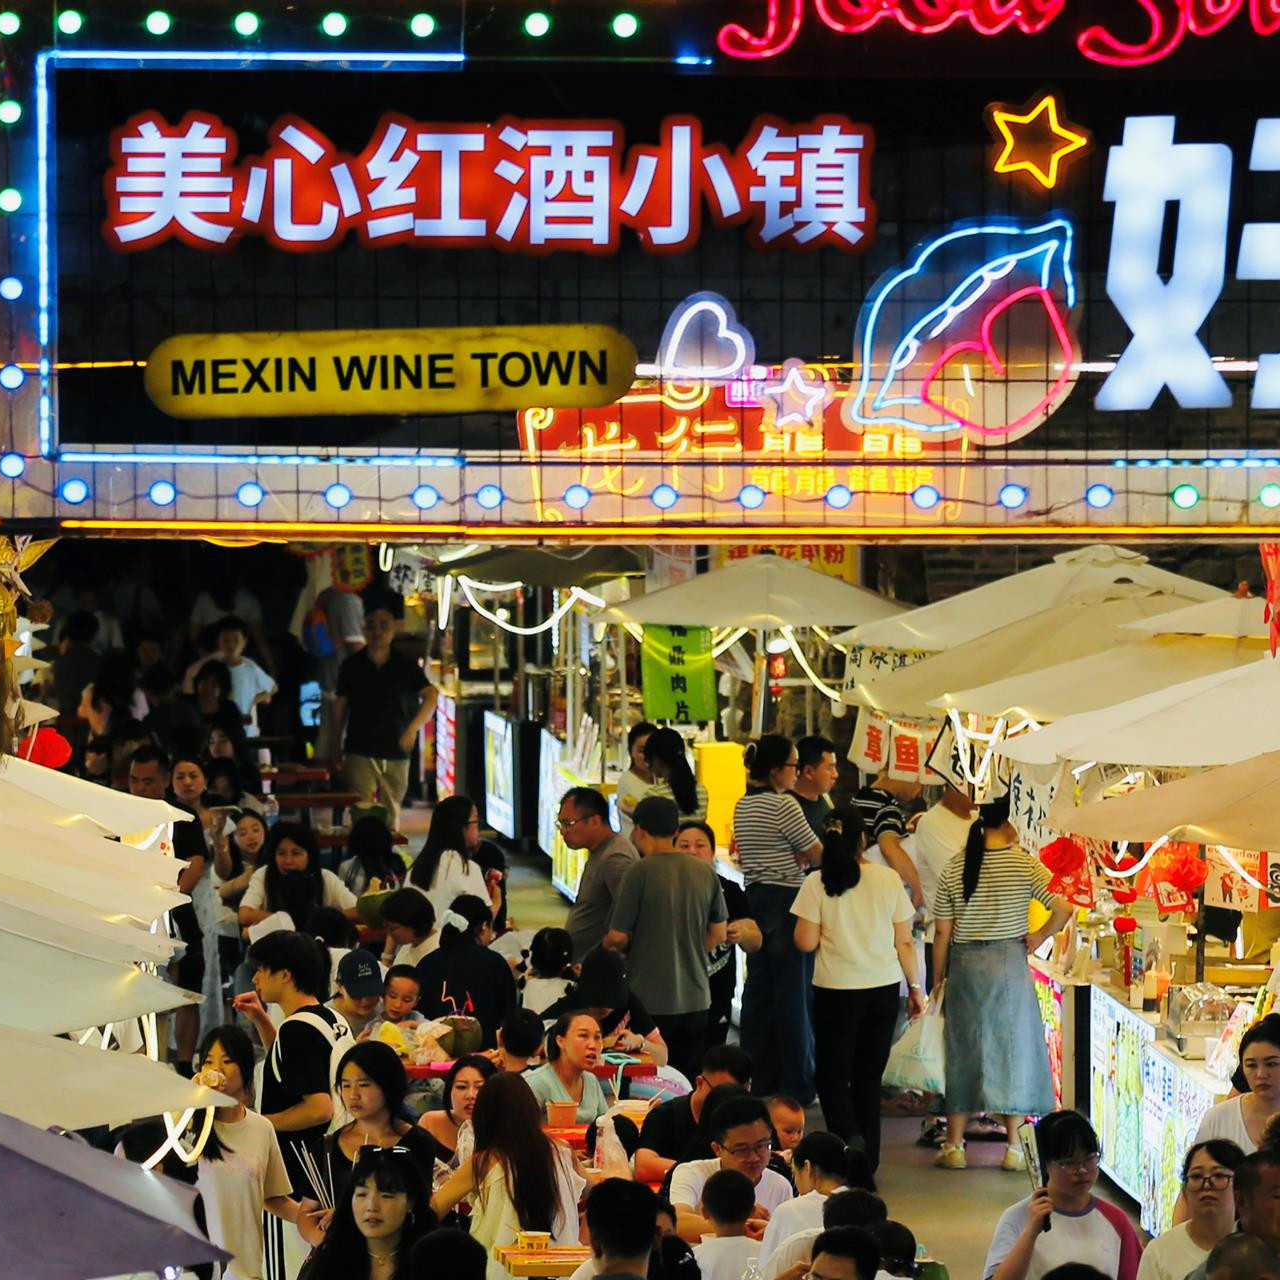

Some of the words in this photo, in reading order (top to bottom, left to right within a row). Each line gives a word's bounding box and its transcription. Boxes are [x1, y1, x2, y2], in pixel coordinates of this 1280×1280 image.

[112, 119, 867, 248] 美心红酒小镇
[170, 349, 317, 396] MEXIN
[334, 345, 456, 393] WINE
[469, 340, 609, 388] TOWN
